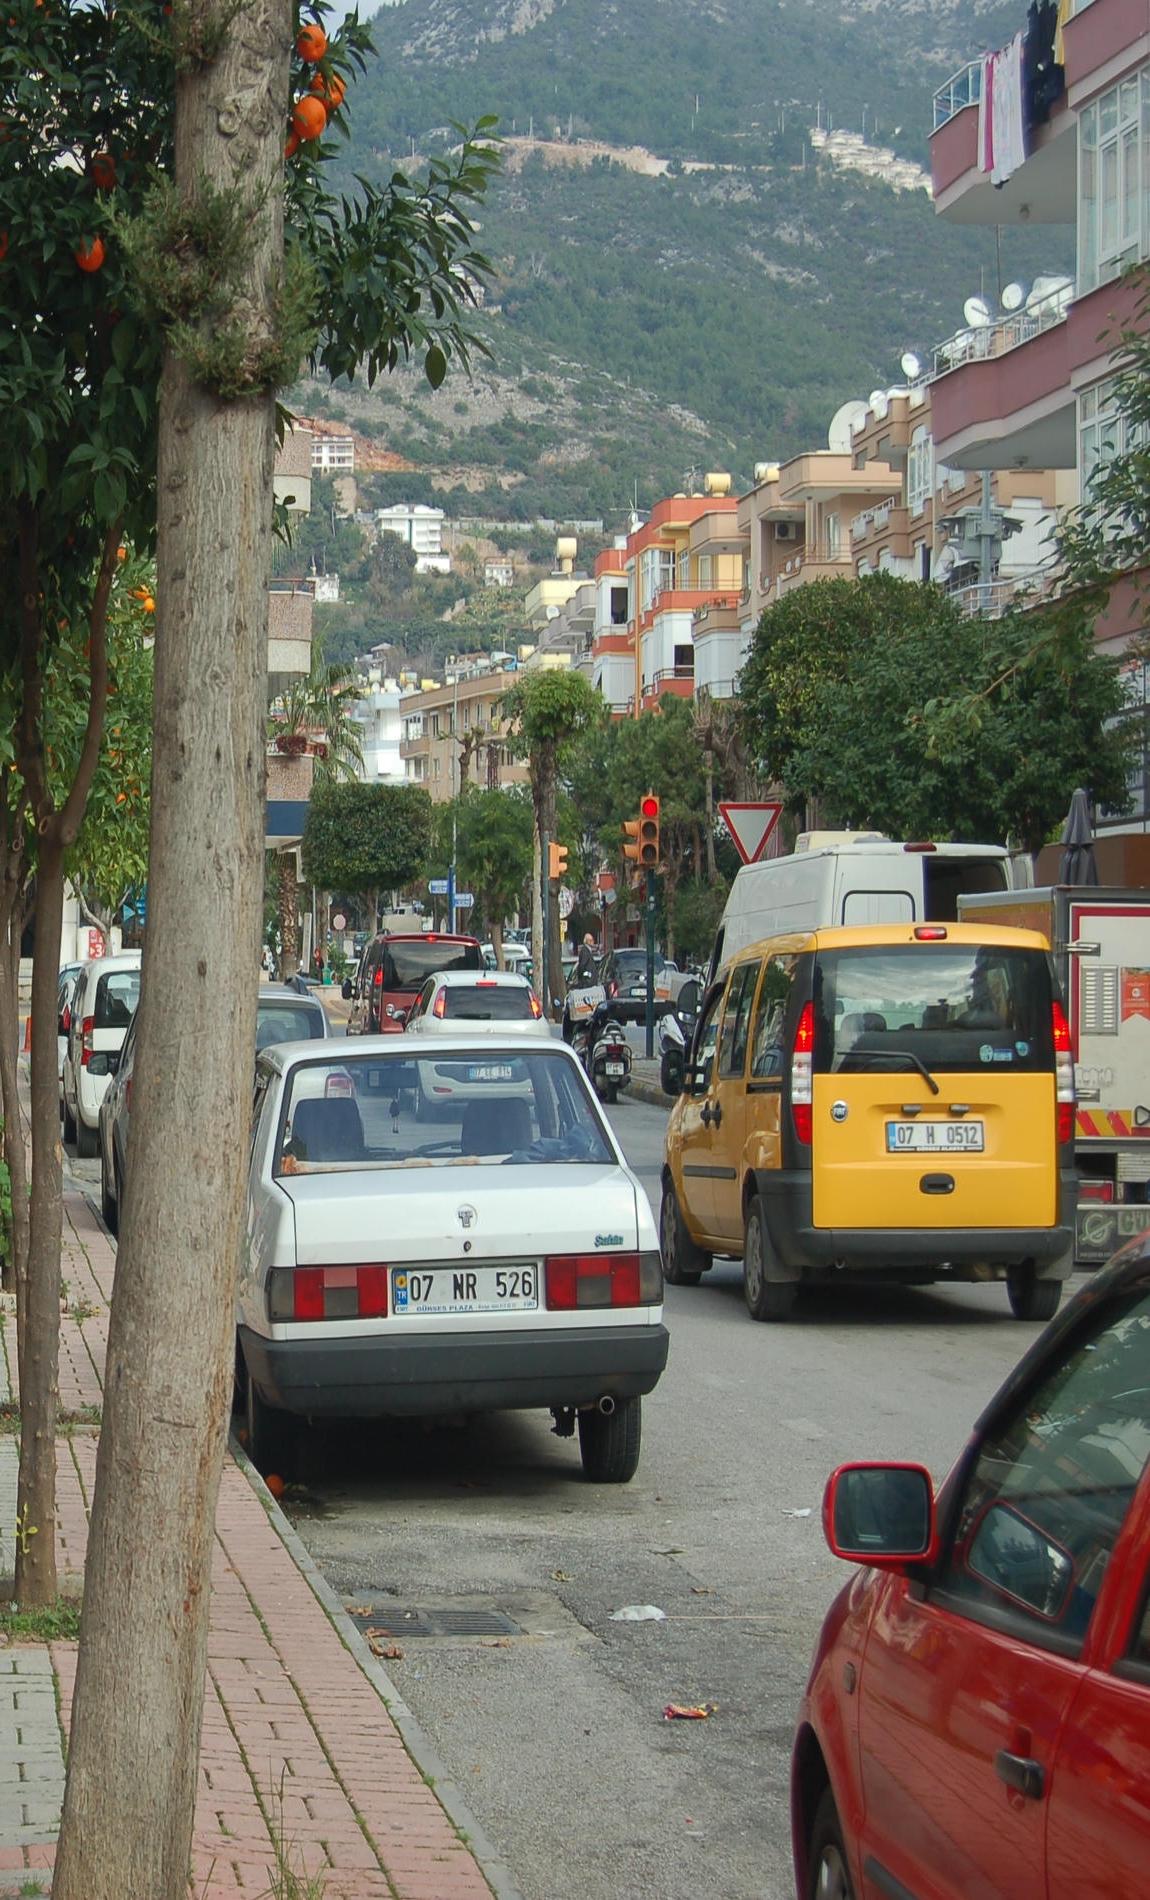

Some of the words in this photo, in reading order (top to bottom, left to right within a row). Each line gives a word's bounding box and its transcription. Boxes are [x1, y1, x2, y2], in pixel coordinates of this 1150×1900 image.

[898, 1126, 914, 1144] 07
[926, 1125, 935, 1144] H
[947, 1126, 978, 1144] 0512
[397, 1290, 407, 1300] TR
[410, 1275, 433, 1301] 07
[452, 1273, 477, 1300] NR
[496, 1271, 532, 1297] 526
